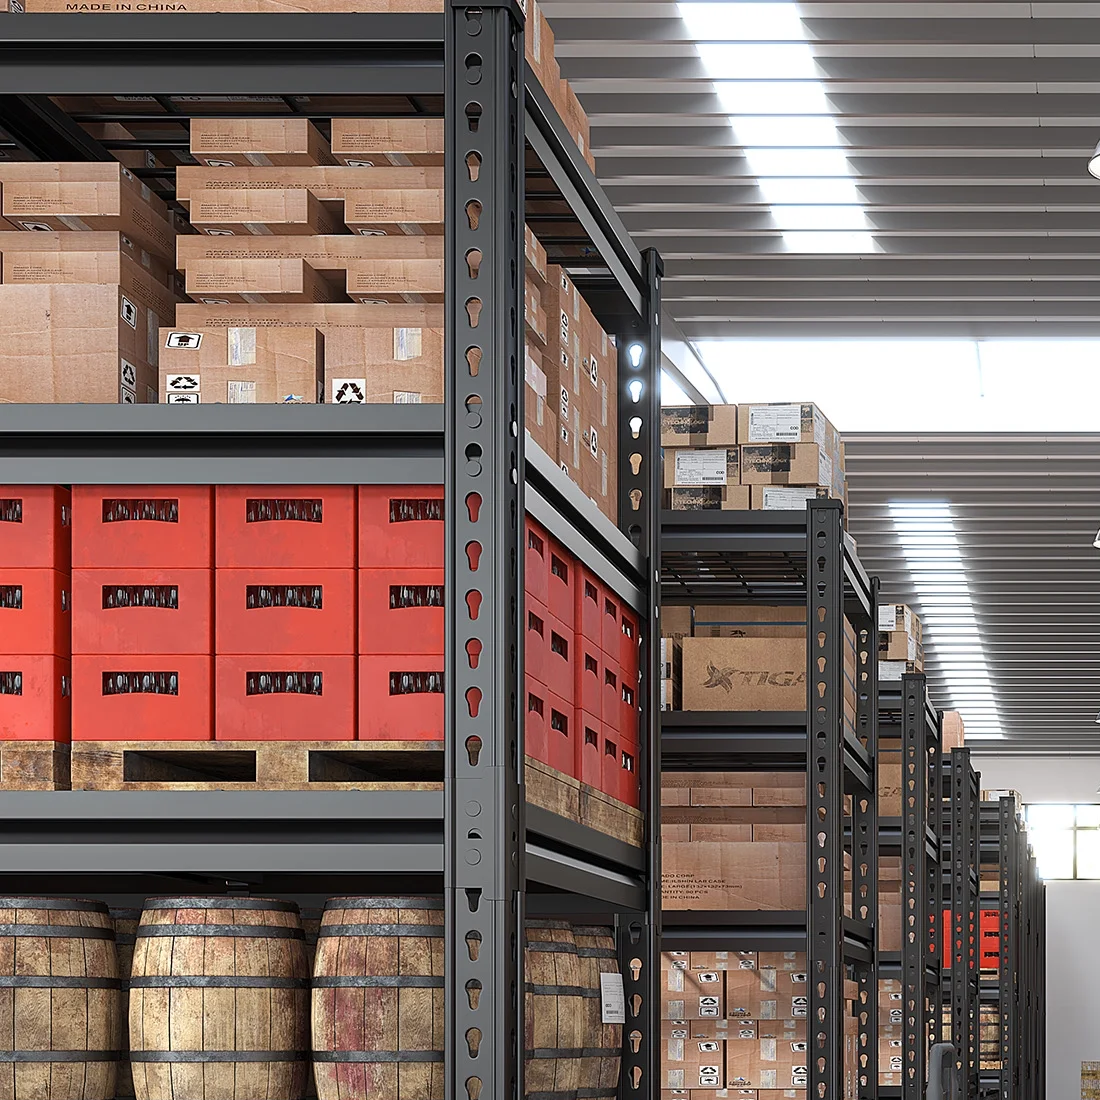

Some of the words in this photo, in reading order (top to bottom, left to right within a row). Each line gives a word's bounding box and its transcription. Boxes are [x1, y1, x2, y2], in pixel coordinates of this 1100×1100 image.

[66, 3, 111, 11] MADE
[116, 3, 131, 11] IN
[136, 3, 188, 11] CHINA
